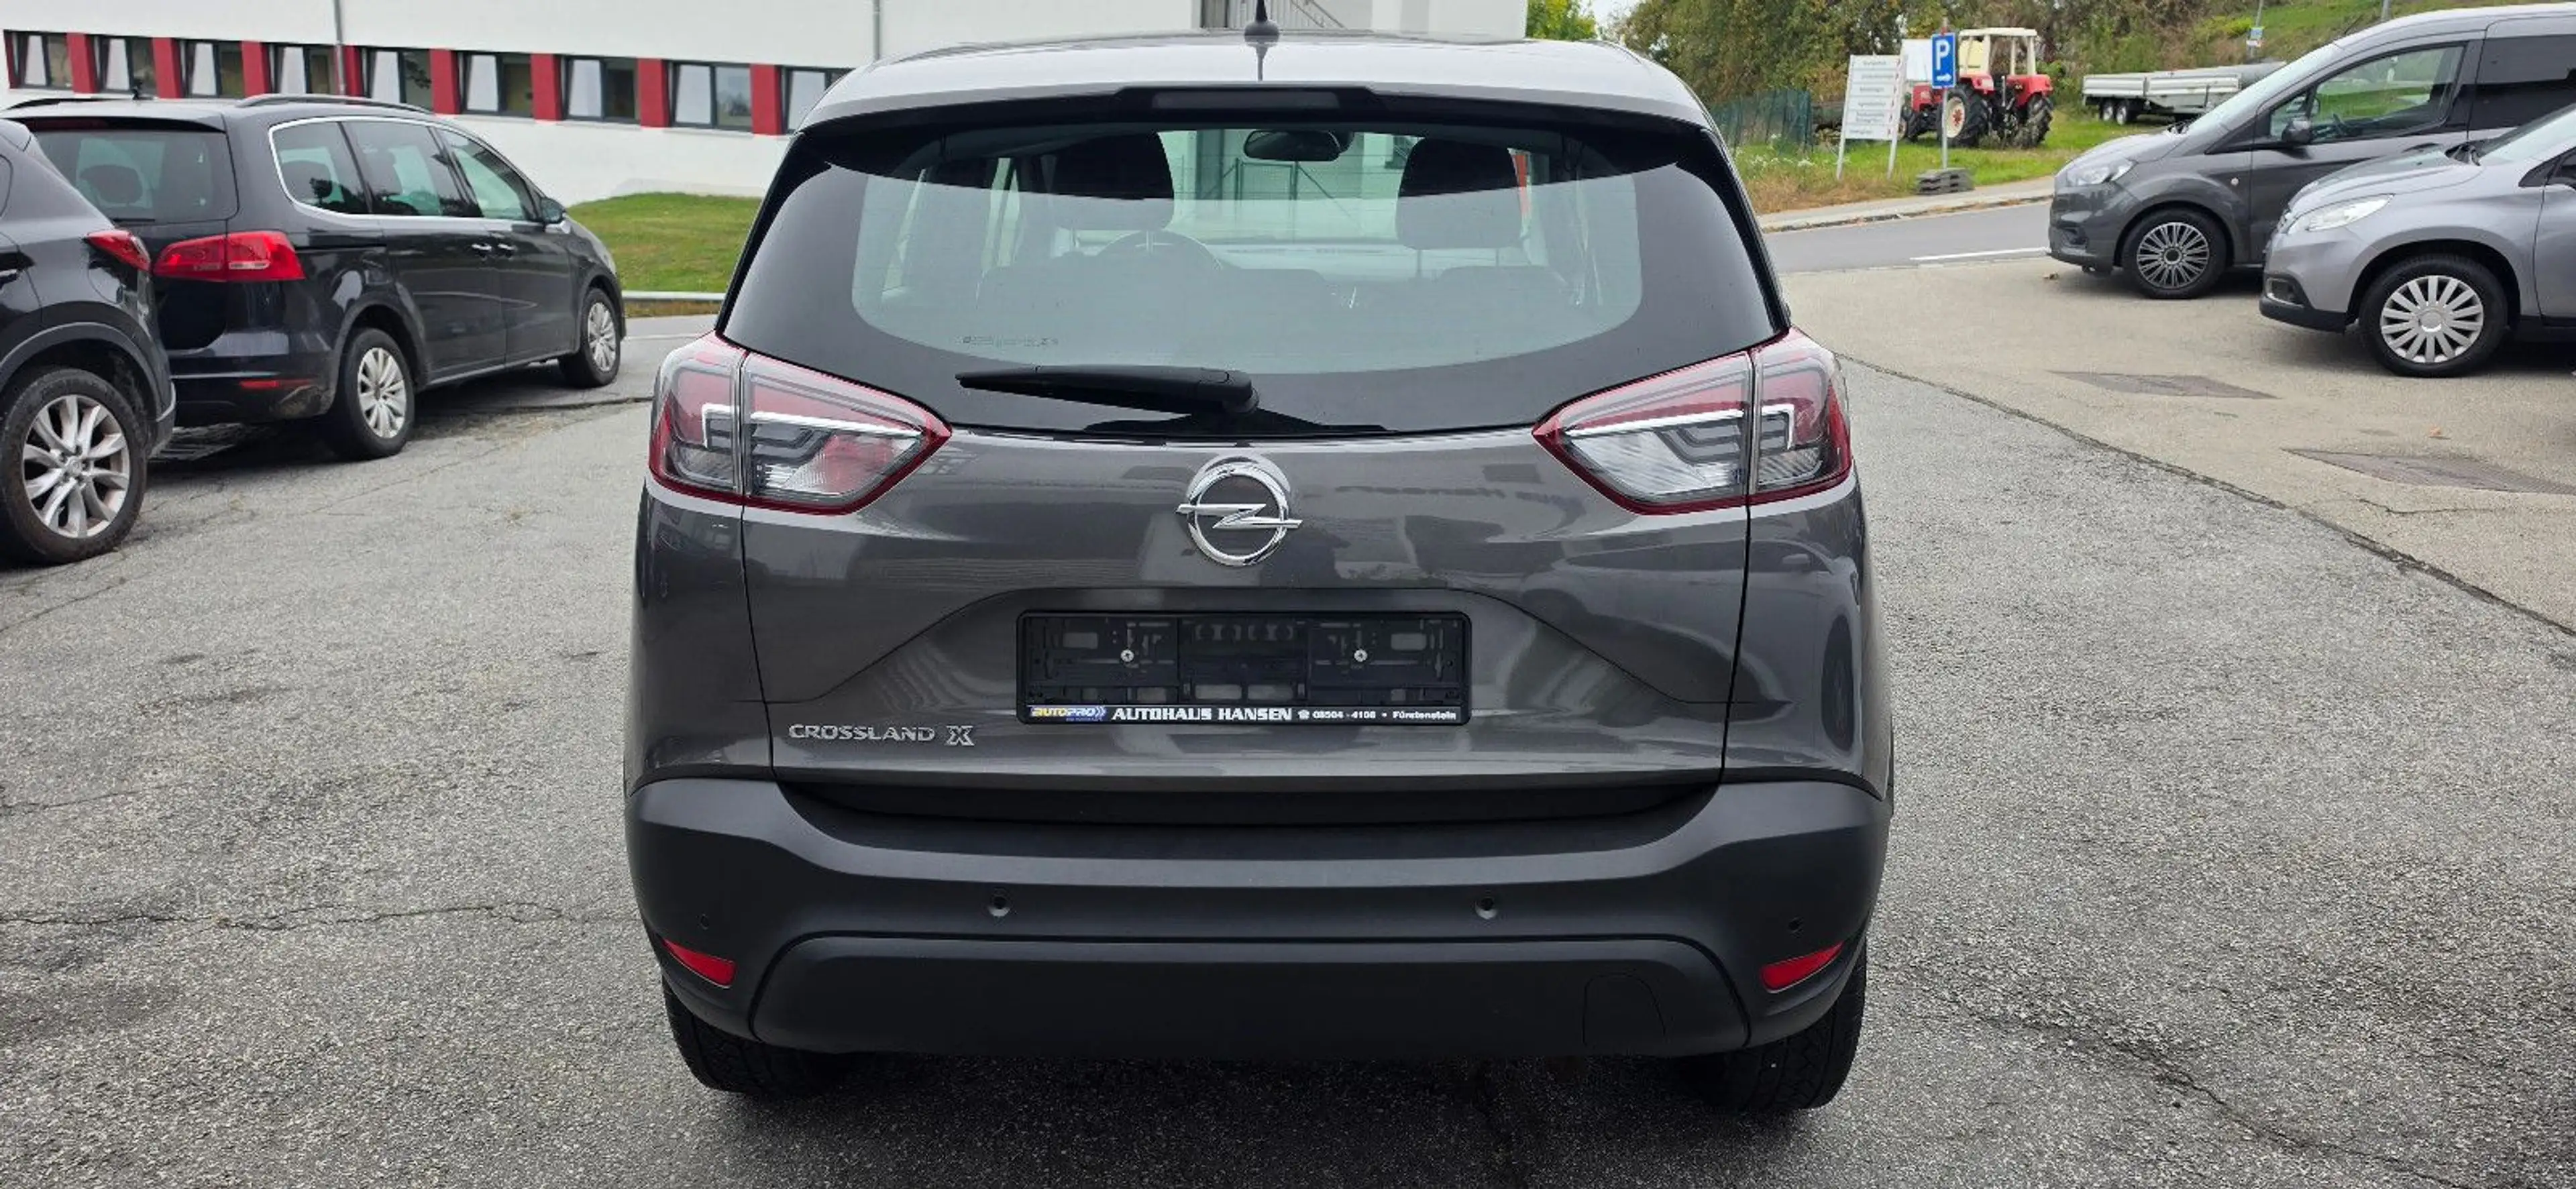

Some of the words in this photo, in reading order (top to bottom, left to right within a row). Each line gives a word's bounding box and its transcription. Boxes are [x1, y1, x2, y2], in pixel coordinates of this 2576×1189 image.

[1935, 40, 1950, 70] P
[1112, 707, 1212, 721] AUTOHAUS
[1218, 707, 1292, 721] HANSEN
[788, 724, 935, 741] CROSSLAND
[947, 725, 975, 746] X
